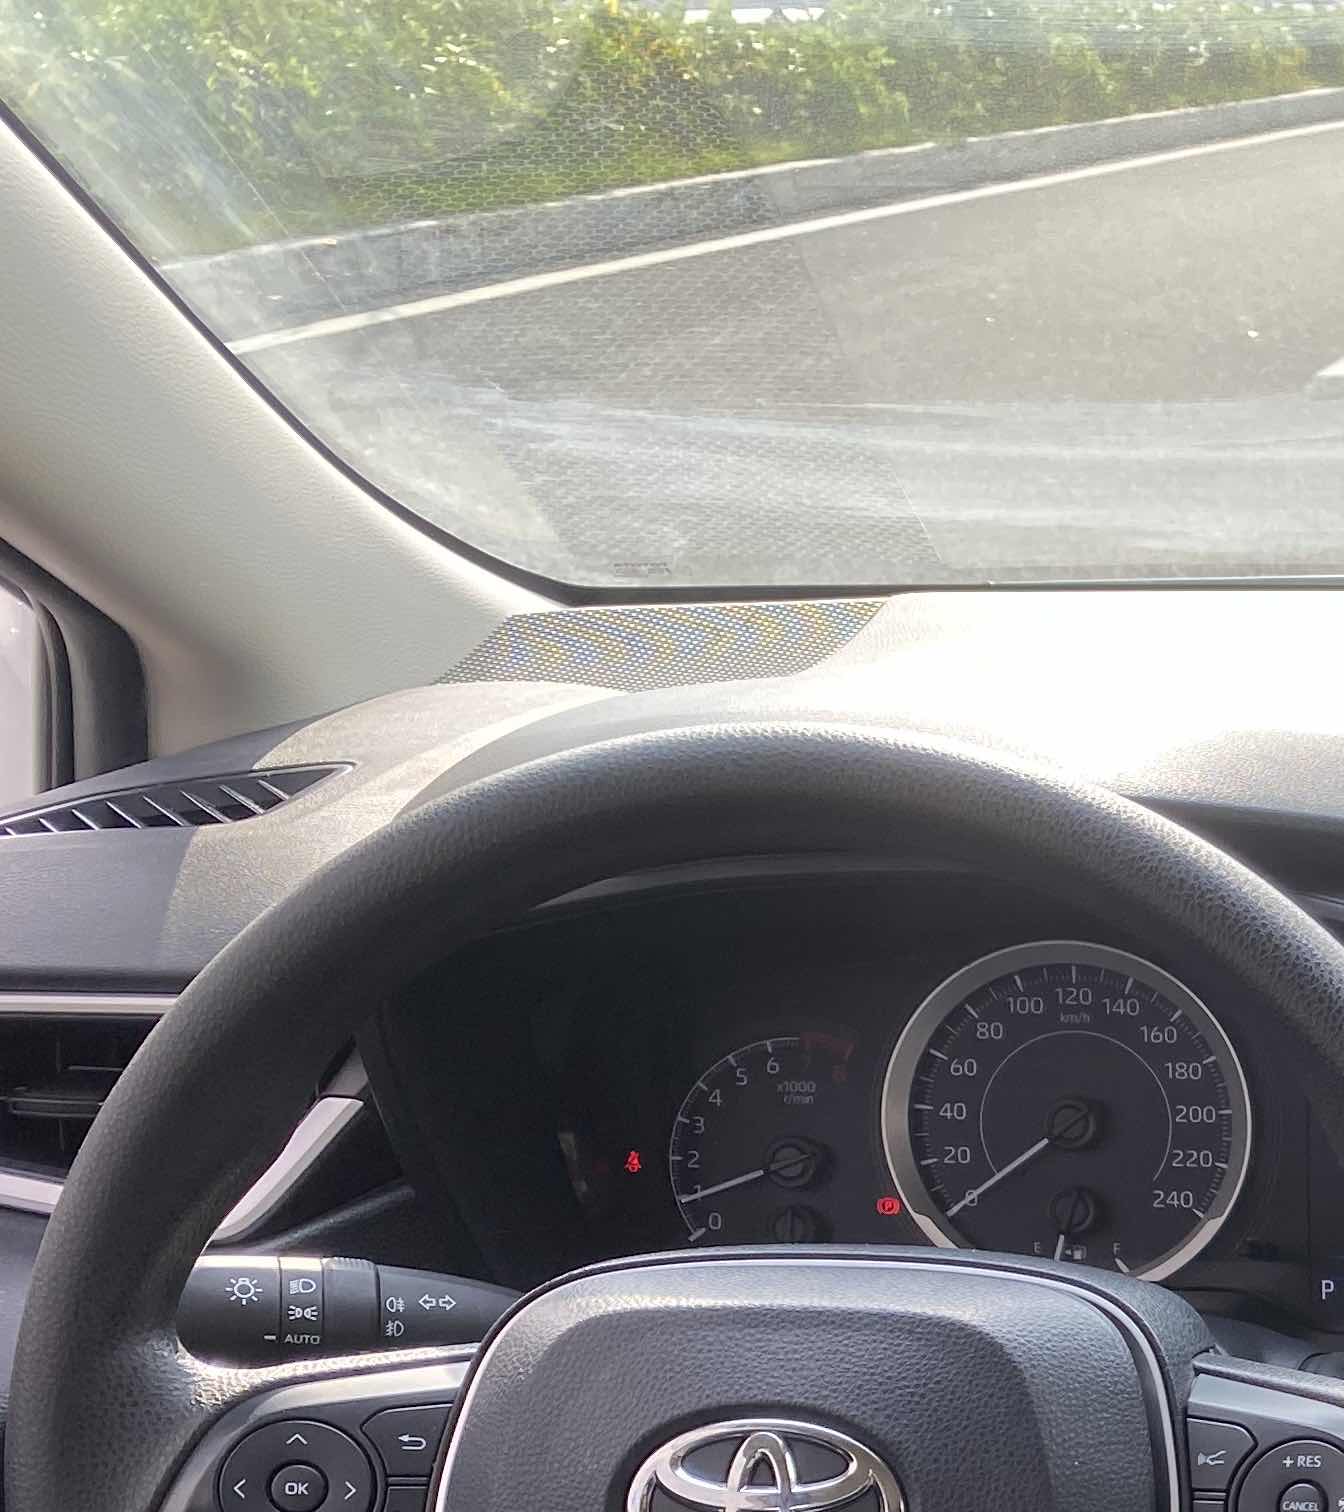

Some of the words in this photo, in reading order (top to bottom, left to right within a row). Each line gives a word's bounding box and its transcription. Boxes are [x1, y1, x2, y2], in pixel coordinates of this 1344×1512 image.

[1055, 987, 1092, 1005] 120
[1007, 997, 1044, 1014] 100
[1102, 998, 1140, 1016] 140
[976, 1022, 1003, 1039] 80
[1139, 1026, 1177, 1043] 160
[766, 1056, 780, 1075] 6
[950, 1058, 978, 1076] 60
[1164, 1062, 1202, 1080] 180
[735, 1067, 749, 1086] 5
[708, 1088, 722, 1107] 4
[938, 1102, 968, 1120] 40
[1175, 1105, 1216, 1123] 200
[692, 1116, 706, 1135] 3
[687, 1150, 701, 1169] 2
[943, 1146, 971, 1164] 20
[1171, 1150, 1213, 1168] 220
[1152, 1190, 1194, 1208] 240
[707, 1212, 723, 1231] 0
[1033, 1241, 1042, 1254] E
[1113, 1242, 1121, 1255] F
[1321, 1279, 1335, 1300] P
[284, 1333, 321, 1345] AUTO
[1297, 1455, 1322, 1468] RES
[284, 1482, 309, 1495] OK
[1282, 1501, 1320, 1512] CANCEL
